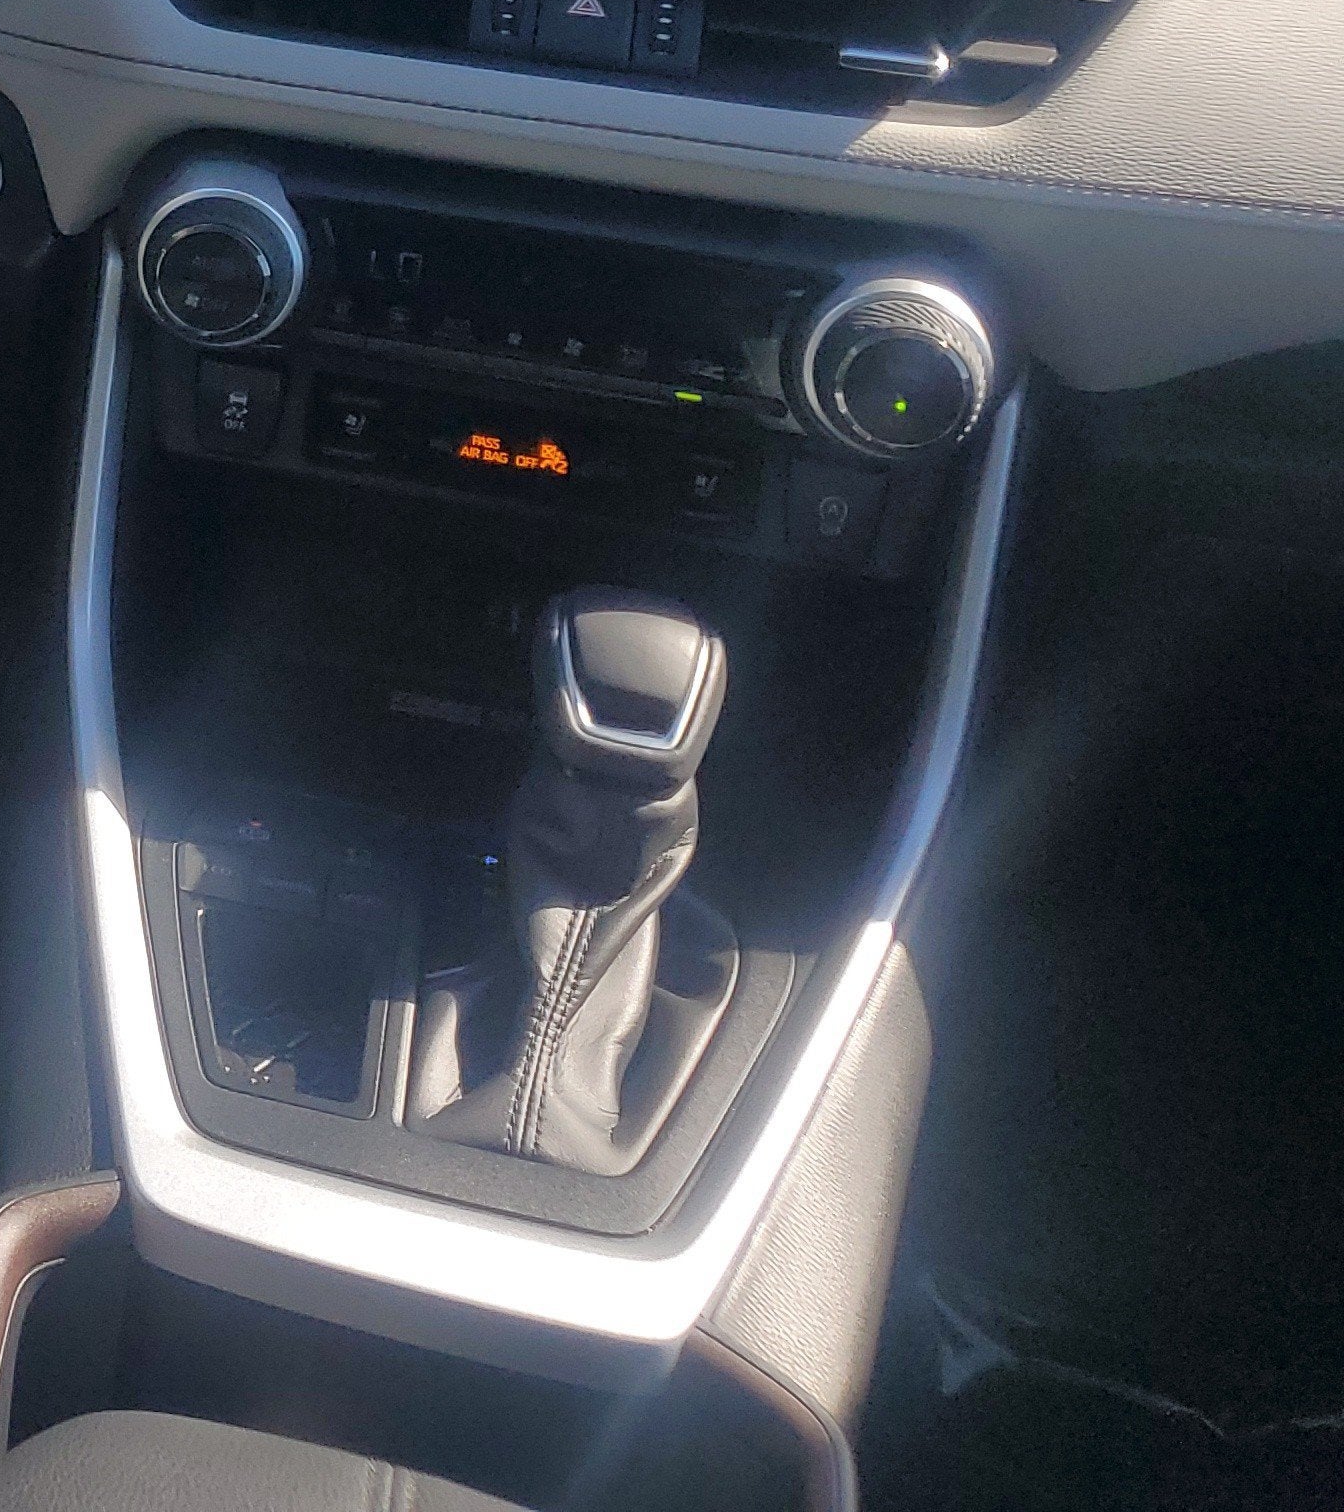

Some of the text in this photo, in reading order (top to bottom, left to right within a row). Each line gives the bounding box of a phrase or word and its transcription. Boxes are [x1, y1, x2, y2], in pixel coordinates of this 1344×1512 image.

[472, 435, 501, 450] PASS
[459, 445, 539, 468] AIR BAG OFF
